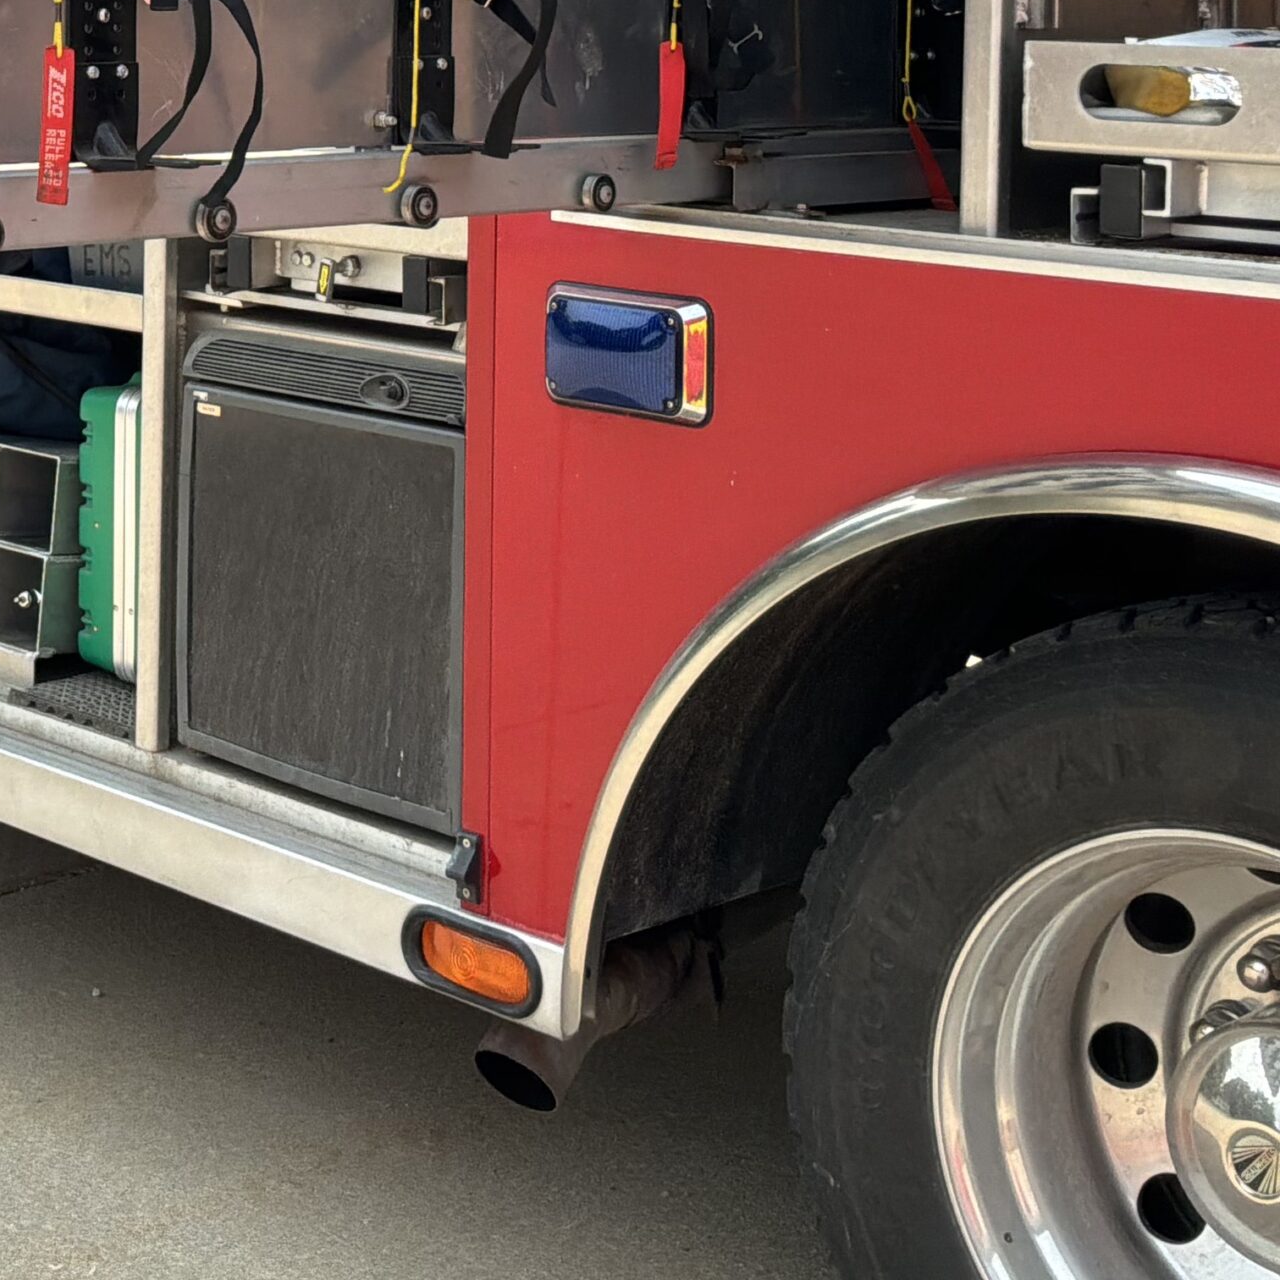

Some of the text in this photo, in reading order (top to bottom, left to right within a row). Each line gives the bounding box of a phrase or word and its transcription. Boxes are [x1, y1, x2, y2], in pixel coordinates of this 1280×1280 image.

[42, 128, 56, 186] RELEASE
[55, 129, 66, 161] PULL
[83, 242, 132, 277] EMS
